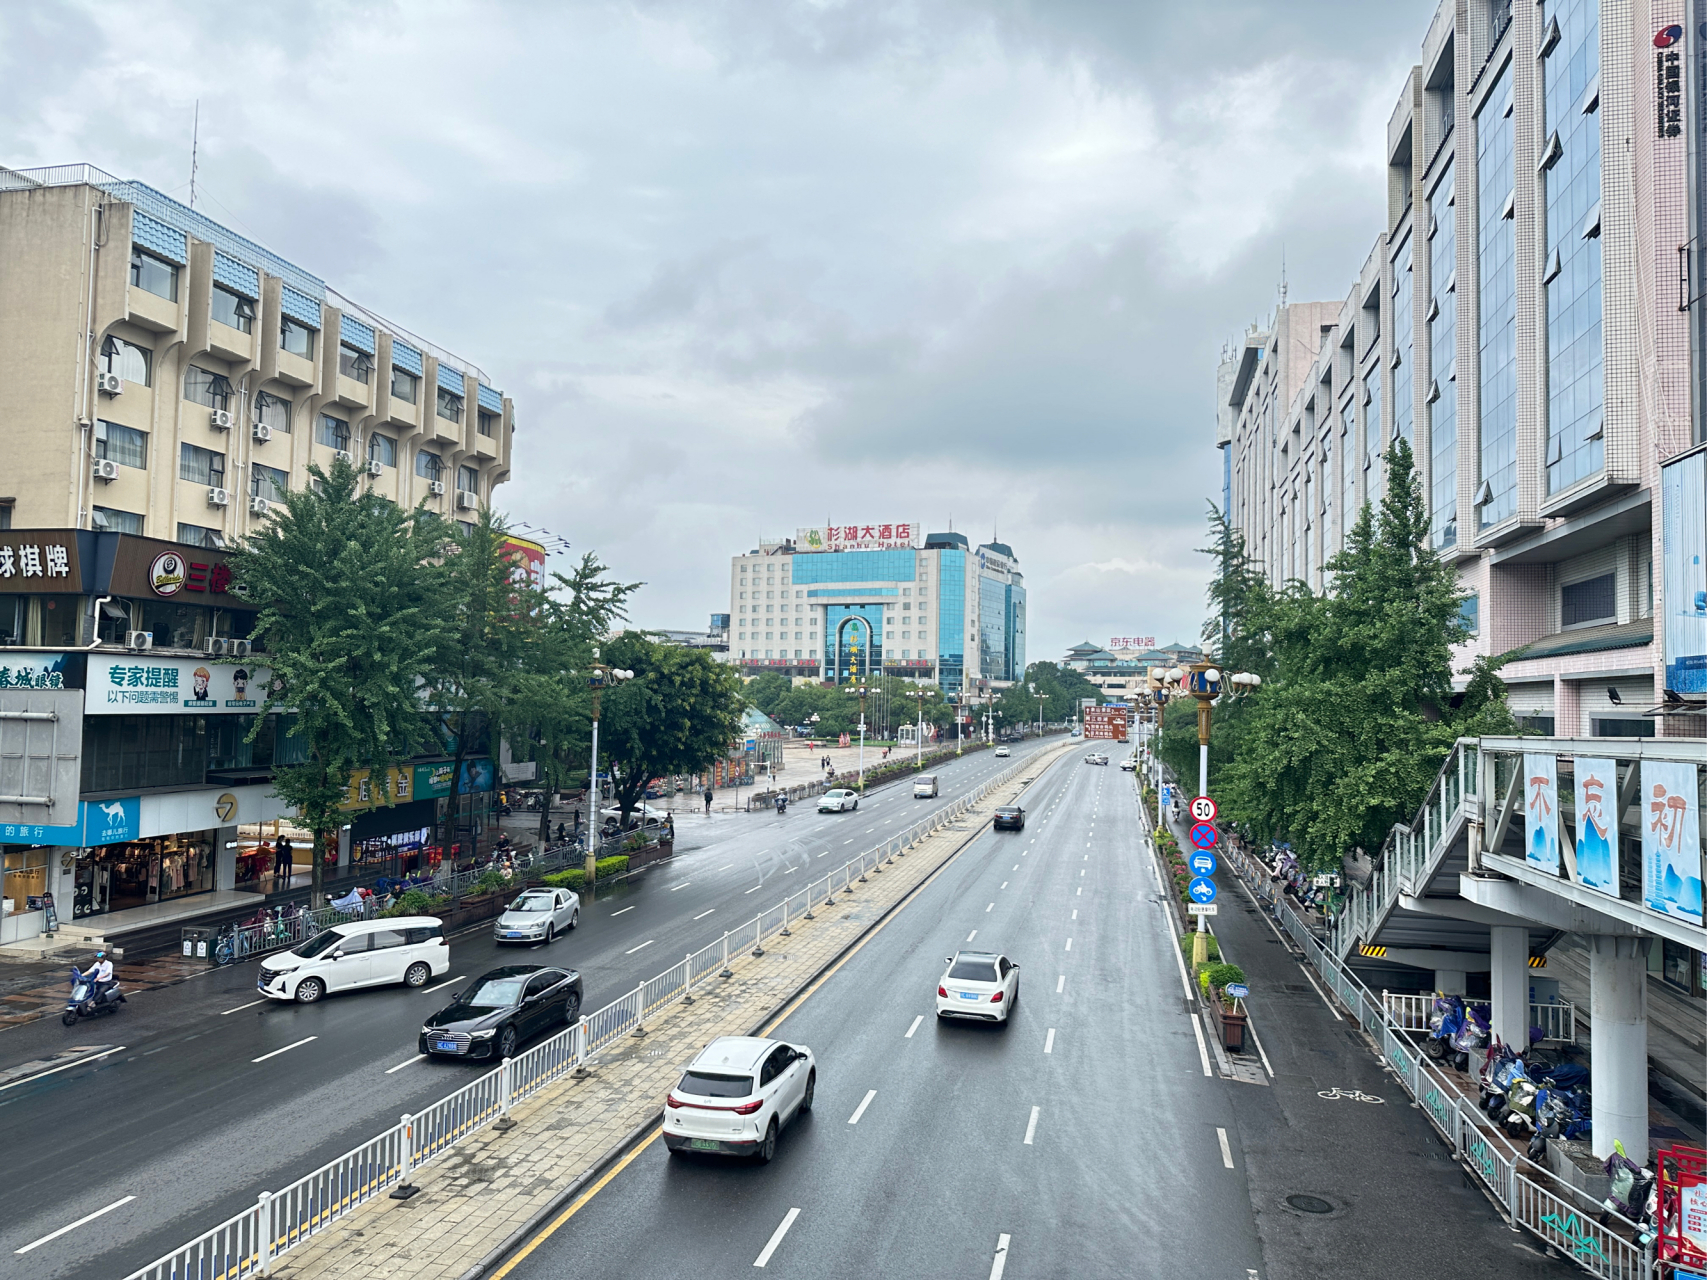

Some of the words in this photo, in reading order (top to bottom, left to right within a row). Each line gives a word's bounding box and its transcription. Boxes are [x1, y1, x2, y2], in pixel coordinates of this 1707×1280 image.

[828, 524, 910, 542] 杉湖大酒店
[878, 540, 910, 548] Hotel
[1110, 637, 1155, 647] 京东电器
[0, 666, 63, 689] 春城眼镜
[108, 665, 179, 688] 专家提醒
[1196, 803, 1210, 817] 50
[1530, 776, 1551, 822] 不
[1582, 774, 1608, 839] 忘
[1651, 784, 1687, 854] 初
